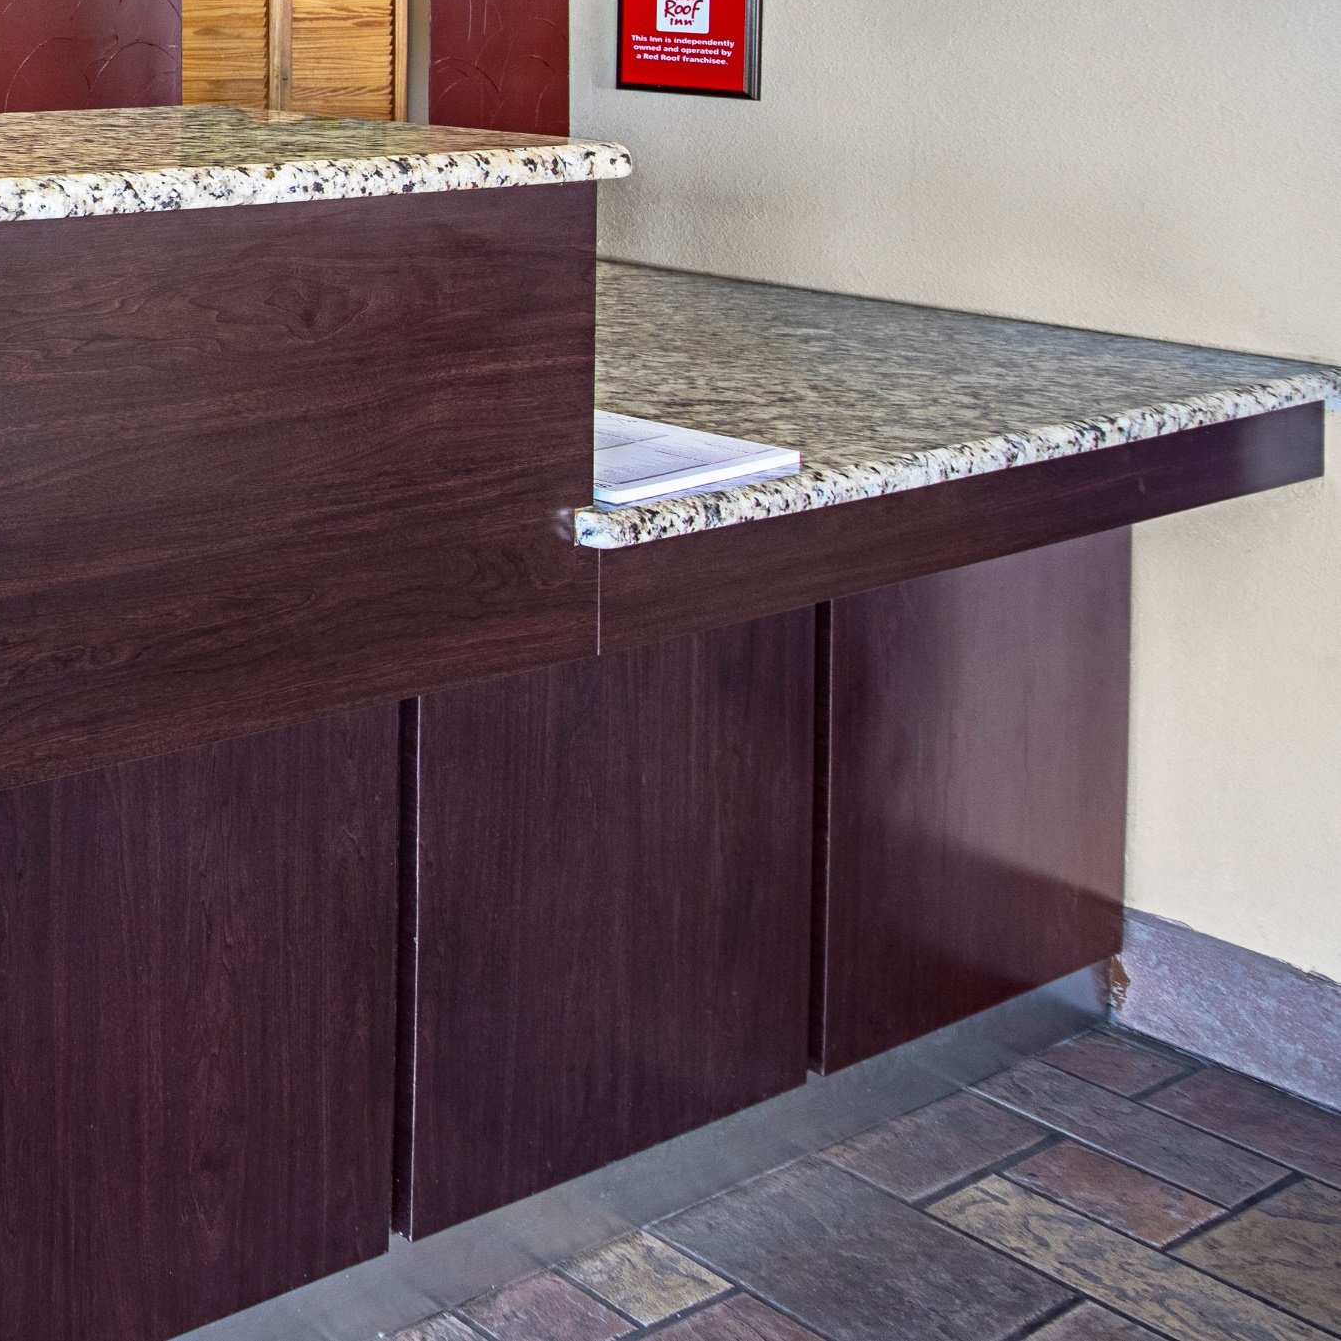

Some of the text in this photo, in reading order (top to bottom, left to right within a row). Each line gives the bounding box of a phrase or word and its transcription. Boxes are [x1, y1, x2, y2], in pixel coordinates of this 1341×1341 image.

[664, 0, 703, 19] Roof
[674, 37, 734, 48] independently
[681, 47, 719, 55] operated
[721, 49, 732, 57] by
[682, 56, 728, 65] franchisee.
